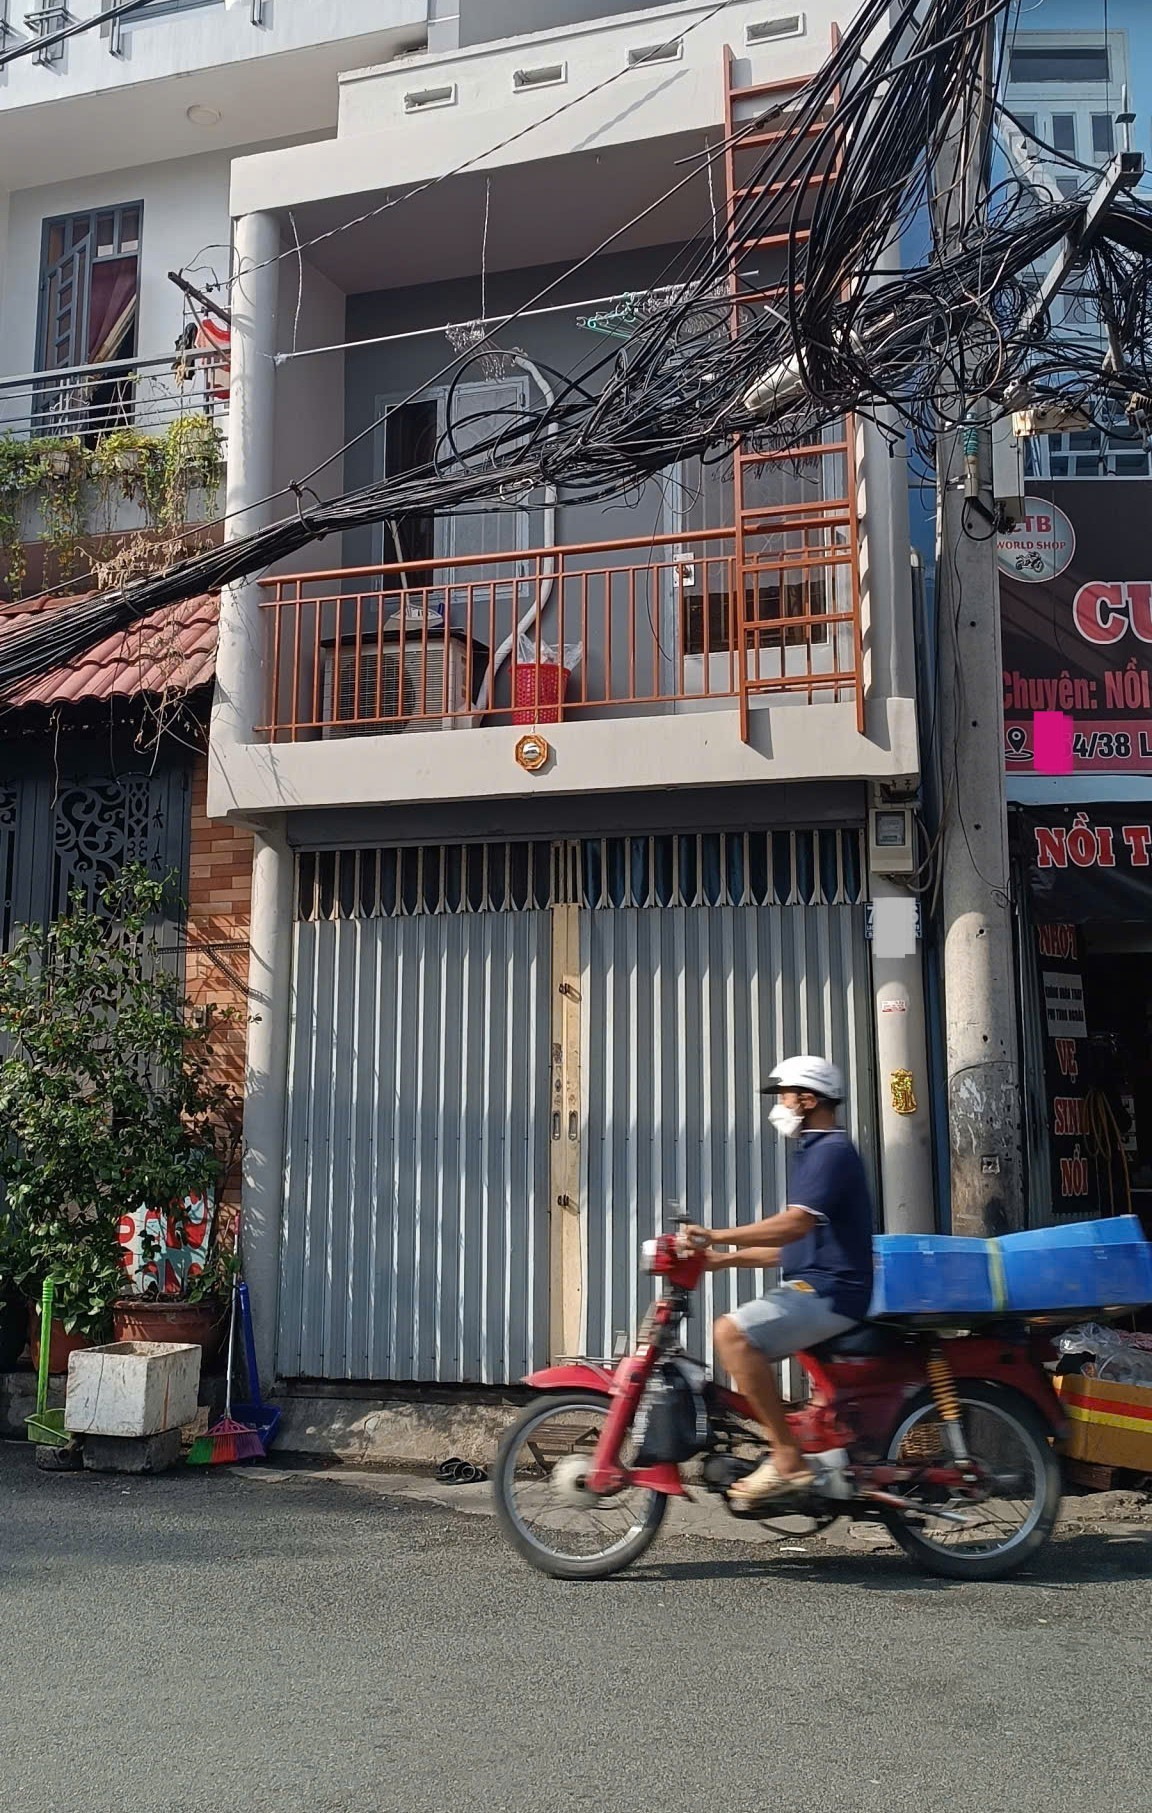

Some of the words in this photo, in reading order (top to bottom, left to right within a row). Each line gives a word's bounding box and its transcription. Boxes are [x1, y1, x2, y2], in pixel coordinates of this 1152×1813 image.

[1012, 515, 1052, 533] TB
[997, 541, 1034, 550] WORLD
[1036, 541, 1066, 550] SHOP
[1064, 732, 1132, 759] 4/38
[1034, 812, 1115, 867] NỒI
